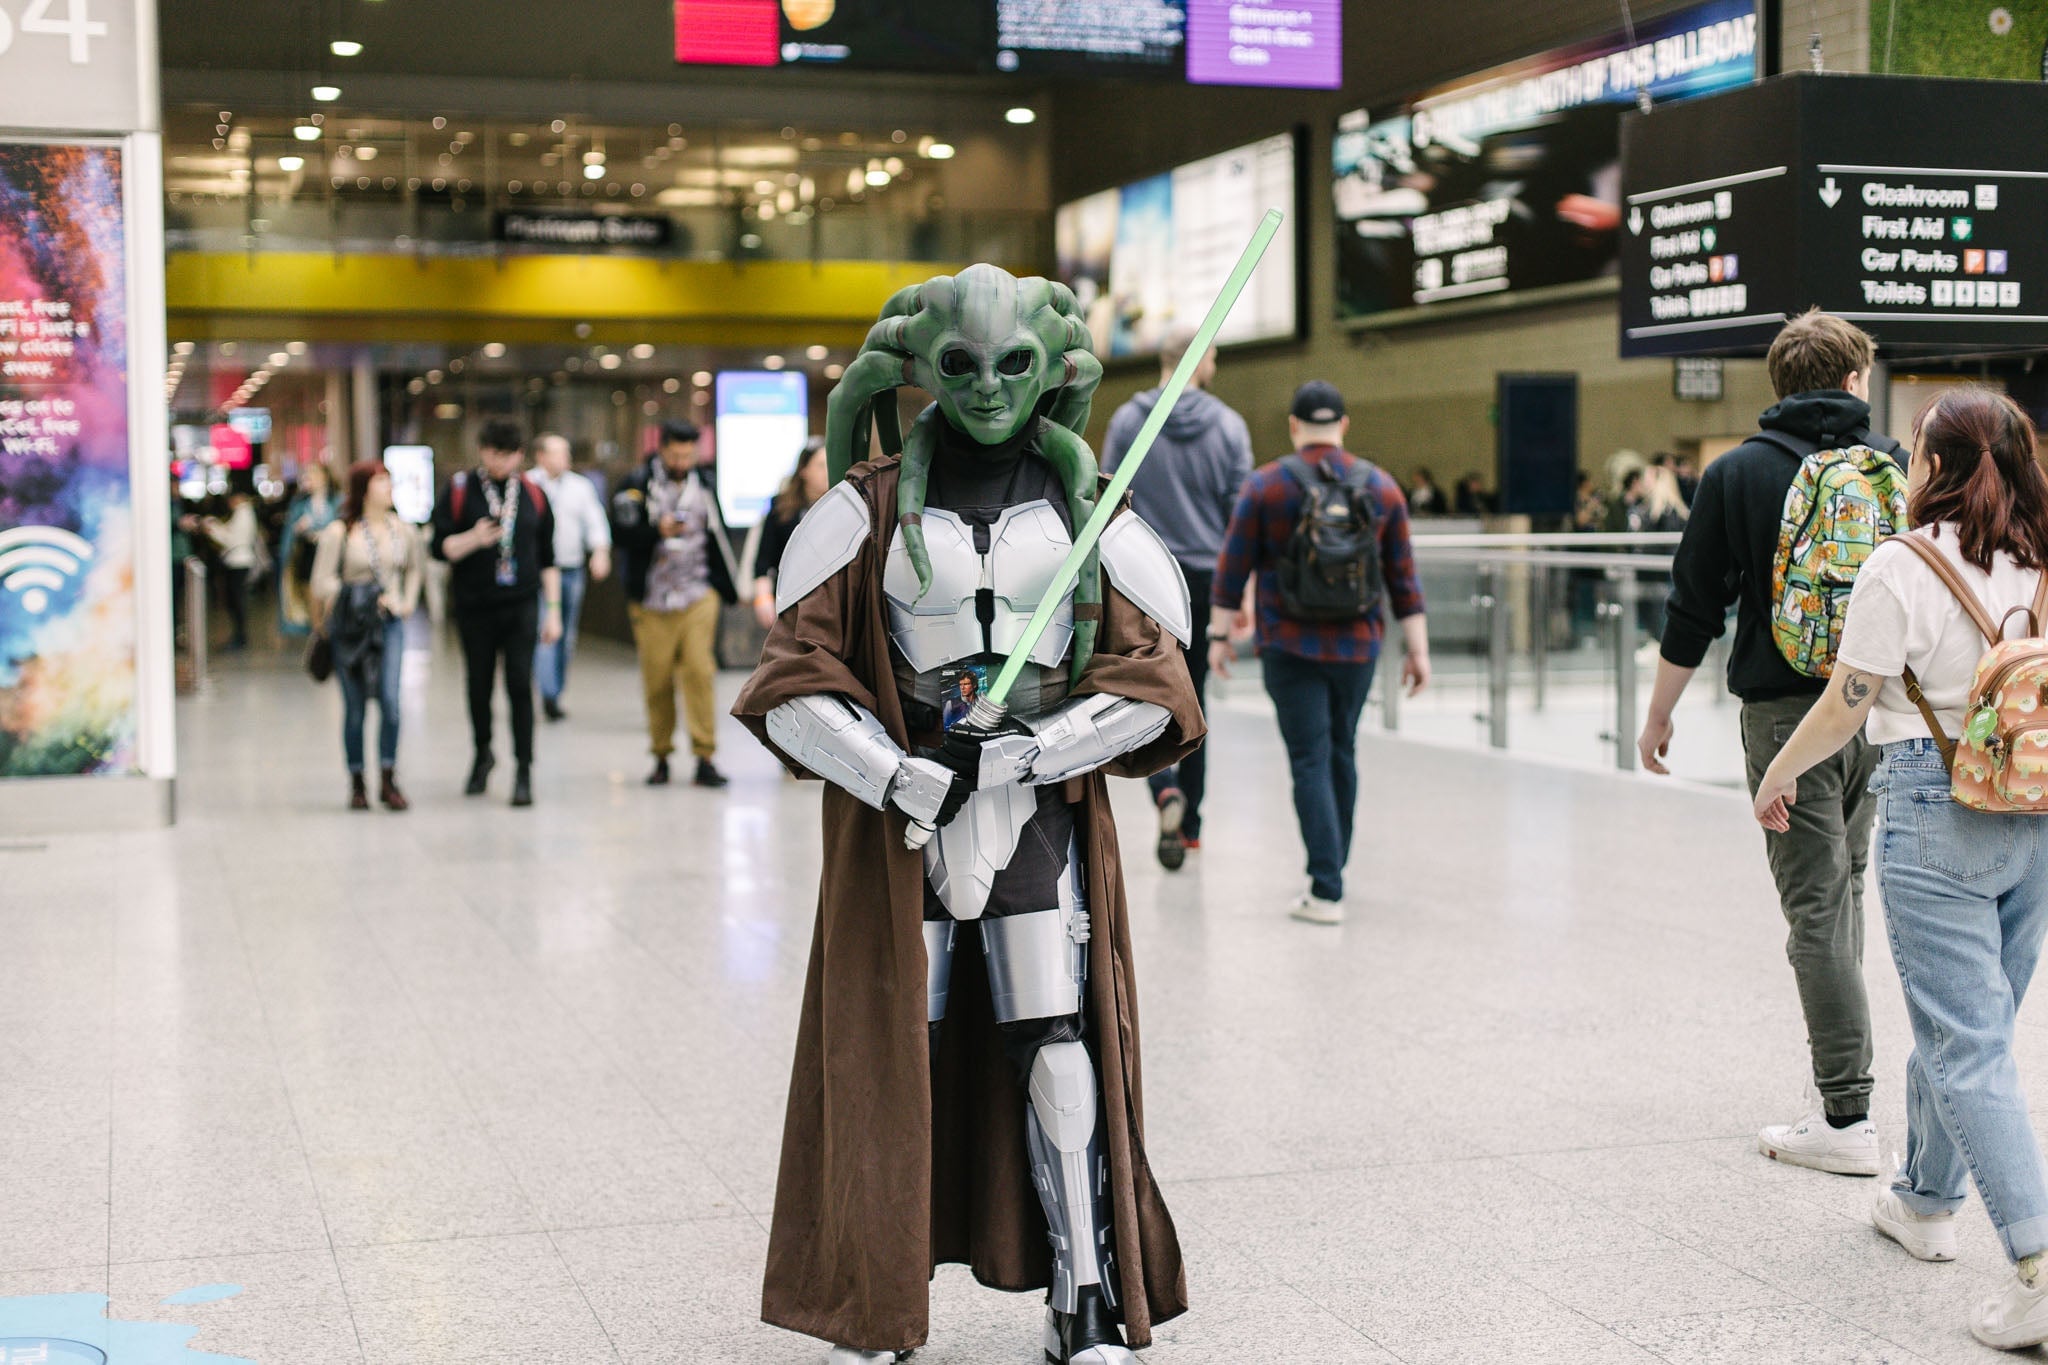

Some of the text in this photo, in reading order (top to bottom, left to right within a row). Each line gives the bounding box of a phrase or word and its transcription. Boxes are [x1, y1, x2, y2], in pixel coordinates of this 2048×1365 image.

[0, 0, 107, 63] 4
[1862, 182, 1970, 208] Cloakroom
[1651, 201, 1714, 229] Cloakroom
[1862, 215, 1945, 240] First Aid
[1651, 230, 1700, 260] First Aid
[1861, 247, 1900, 272] Car
[1901, 249, 1958, 273] Parks
[1671, 261, 1708, 287] Parks
[1861, 280, 1927, 304] Toilets
[32, 299, 71, 318] free
[1650, 294, 1690, 321] Toilets
[20, 319, 38, 336] is
[38, 319, 74, 340] just
[75, 321, 90, 337] a
[20, 338, 75, 357] clicks
[24, 400, 50, 417] on
[52, 399, 75, 417] to
[41, 417, 81, 437] free
